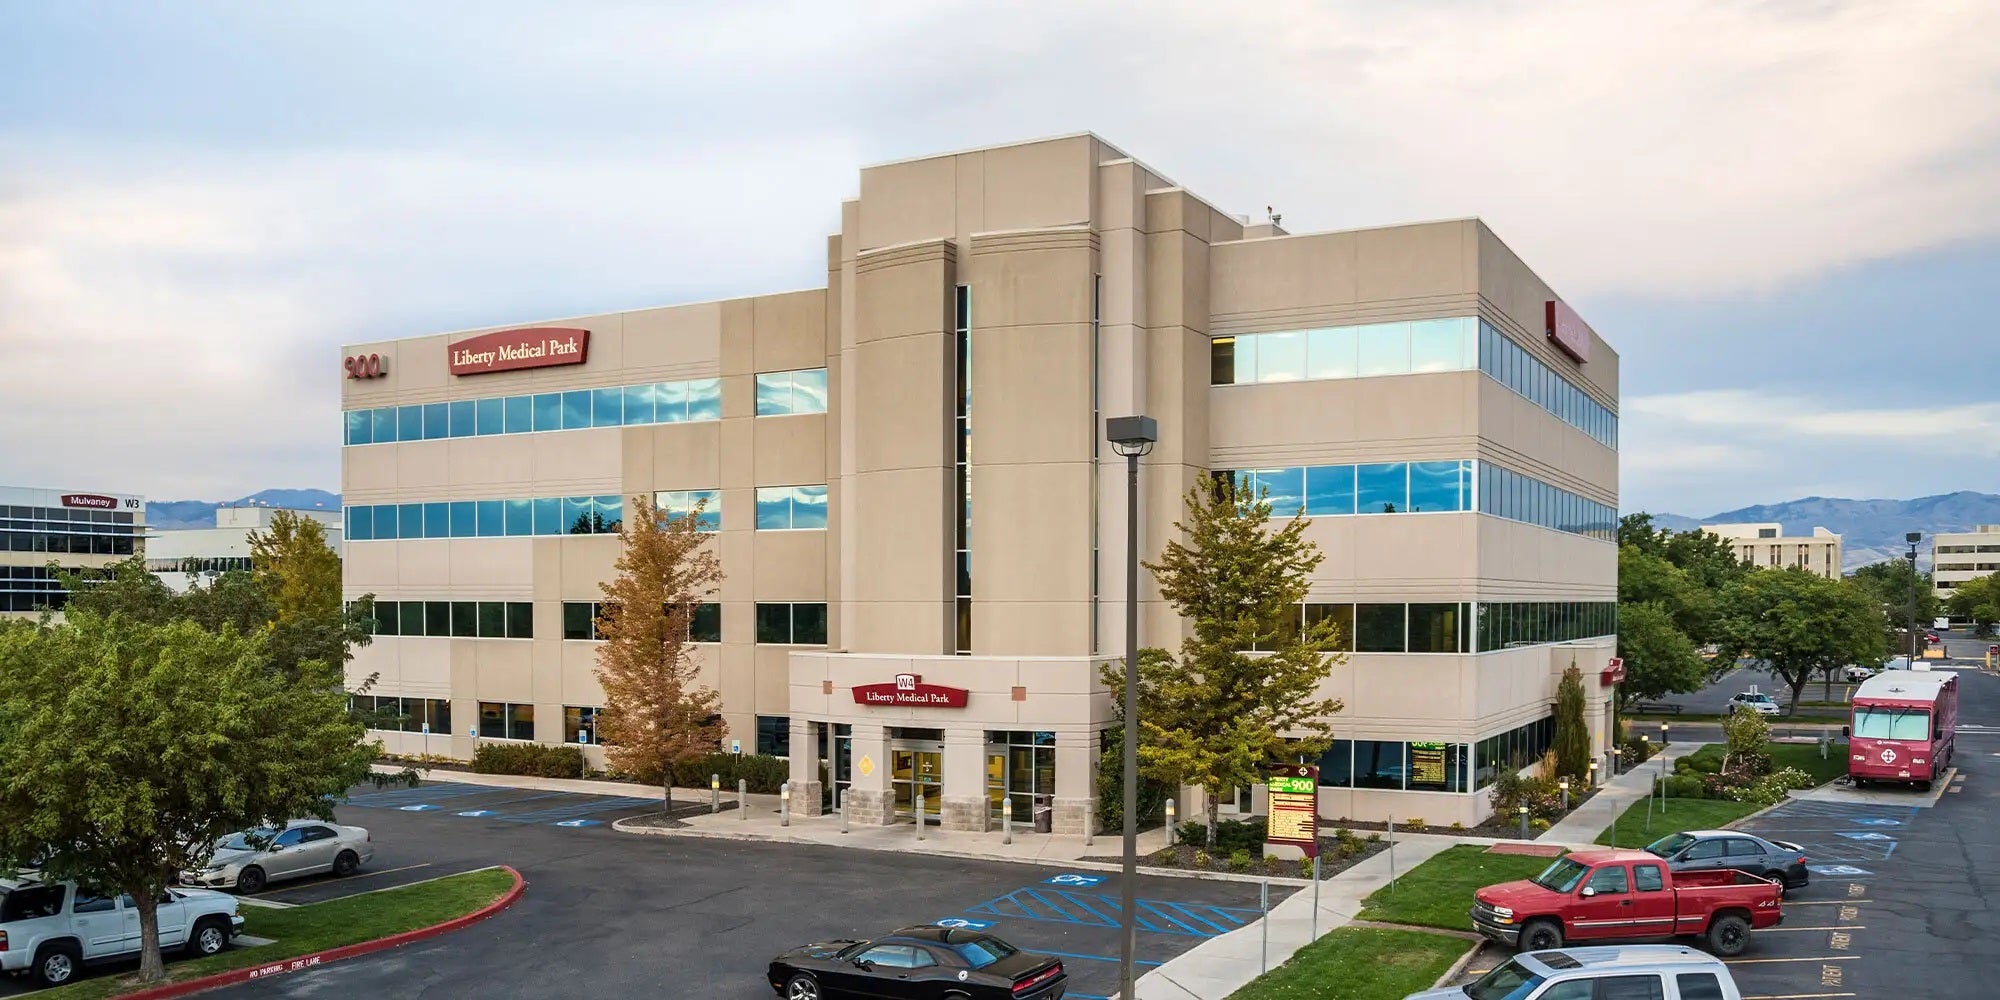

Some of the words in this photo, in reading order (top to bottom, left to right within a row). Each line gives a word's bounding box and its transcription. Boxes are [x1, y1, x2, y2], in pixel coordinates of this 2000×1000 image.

[453, 349, 495, 367] Liberty
[498, 340, 546, 361] Medical
[549, 337, 578, 356] Park
[71, 496, 110, 507] Mulvaney
[125, 498, 140, 509] W3
[898, 678, 914, 688] W4
[866, 692, 895, 704] Liberty
[896, 692, 928, 703] Medical
[930, 693, 949, 703] Park
[1291, 780, 1314, 791] 900
[249, 970, 259, 979] NO
[260, 964, 283, 976] PARKING
[291, 959, 305, 970] FIRE
[305, 956, 321, 967] LANE
